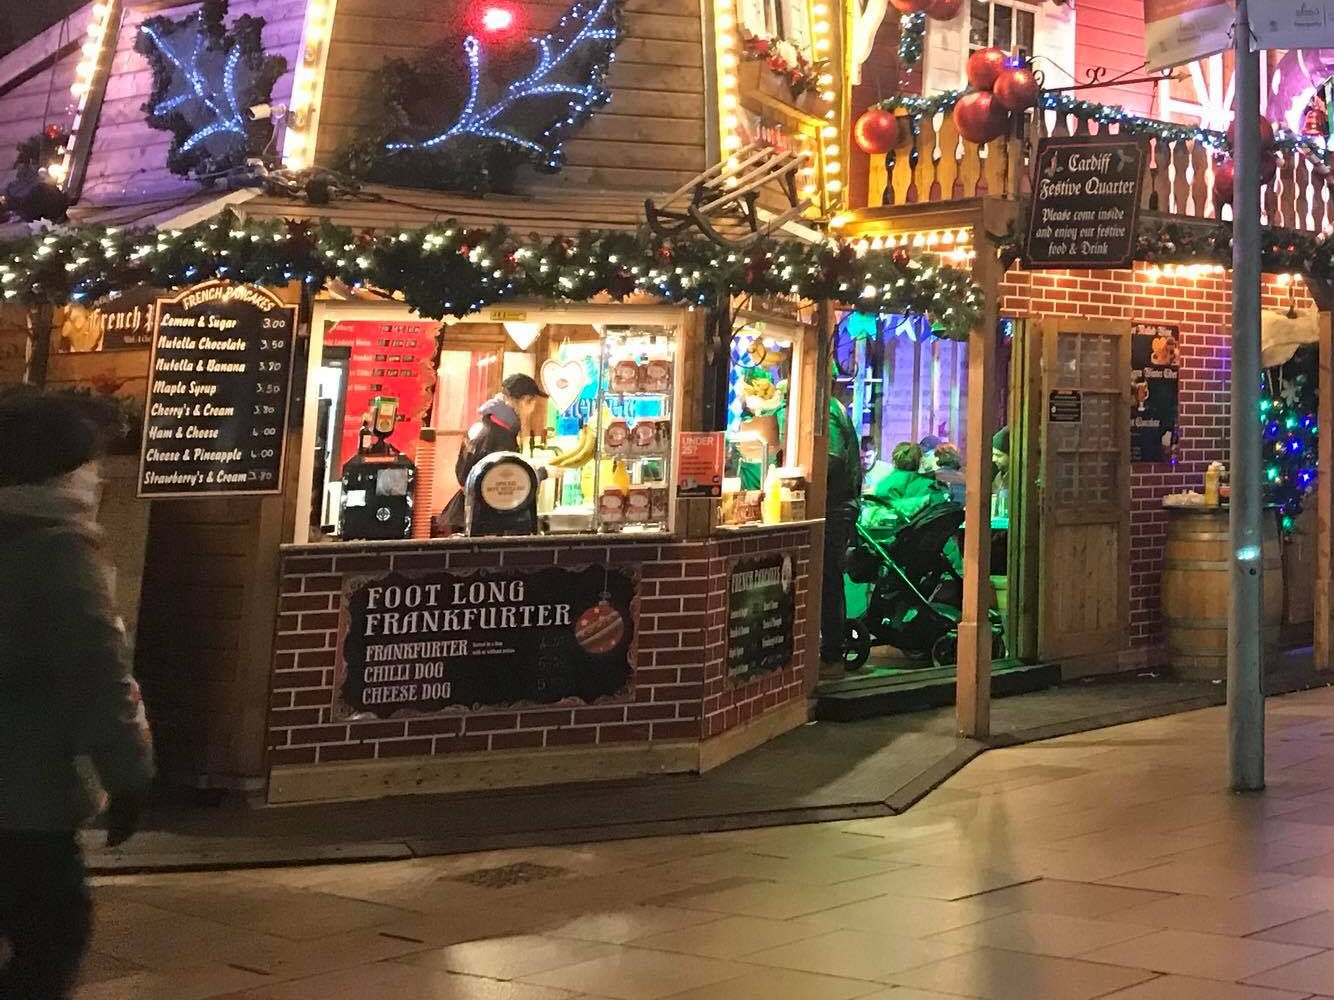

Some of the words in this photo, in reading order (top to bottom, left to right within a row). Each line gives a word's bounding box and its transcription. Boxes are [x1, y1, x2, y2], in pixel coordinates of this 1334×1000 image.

[1068, 152, 1113, 174] Cardiff
[1040, 178, 1081, 200] Festive
[1085, 176, 1135, 195] Quarter
[1042, 208, 1072, 223] Please
[1073, 209, 1096, 221] come
[1098, 207, 1125, 220] inside
[1036, 225, 1053, 239] and
[1054, 225, 1078, 241] enjoy
[1080, 226, 1095, 238] our
[1097, 223, 1126, 239] festive
[1048, 241, 1068, 257] food
[1069, 242, 1077, 255] &
[1081, 240, 1109, 255] Drink
[182, 286, 223, 311] FRENCH
[223, 285, 276, 312] PANCAKES
[88, 306, 141, 333] French
[160, 313, 195, 328] Lemon
[197, 315, 205, 327] &
[207, 314, 237, 331] Sugar
[262, 317, 286, 329] 3.00
[157, 335, 196, 350] Nutella
[198, 336, 246, 350] Chocolate
[260, 339, 285, 350] 3.50
[155, 357, 194, 372] Nutella
[195, 359, 204, 372] &
[206, 358, 246, 373] Banana
[152, 380, 186, 396] Maple
[188, 380, 217, 397] Syrup
[150, 402, 191, 418] Cherry's
[192, 404, 201, 416] &
[203, 403, 235, 417] Cream
[149, 426, 173, 440] Ham
[175, 427, 183, 439] &
[185, 425, 219, 439] Cheese
[681, 436, 714, 446] UNDER
[146, 448, 181, 462] Cheese
[182, 449, 190, 461] &
[193, 448, 243, 463] Pineapple
[143, 471, 203, 486] Strawberry's
[205, 471, 214, 483] &
[216, 470, 247, 483] Cream
[366, 583, 442, 610] FOOT
[451, 580, 525, 605] LONG
[363, 604, 572, 636] FRANKFURTER
[364, 639, 469, 662] FRANKFURTER
[363, 663, 410, 683] CHILLI
[414, 661, 444, 680] DOG
[362, 684, 418, 705] CHEESE
[421, 681, 452, 701] DOG
